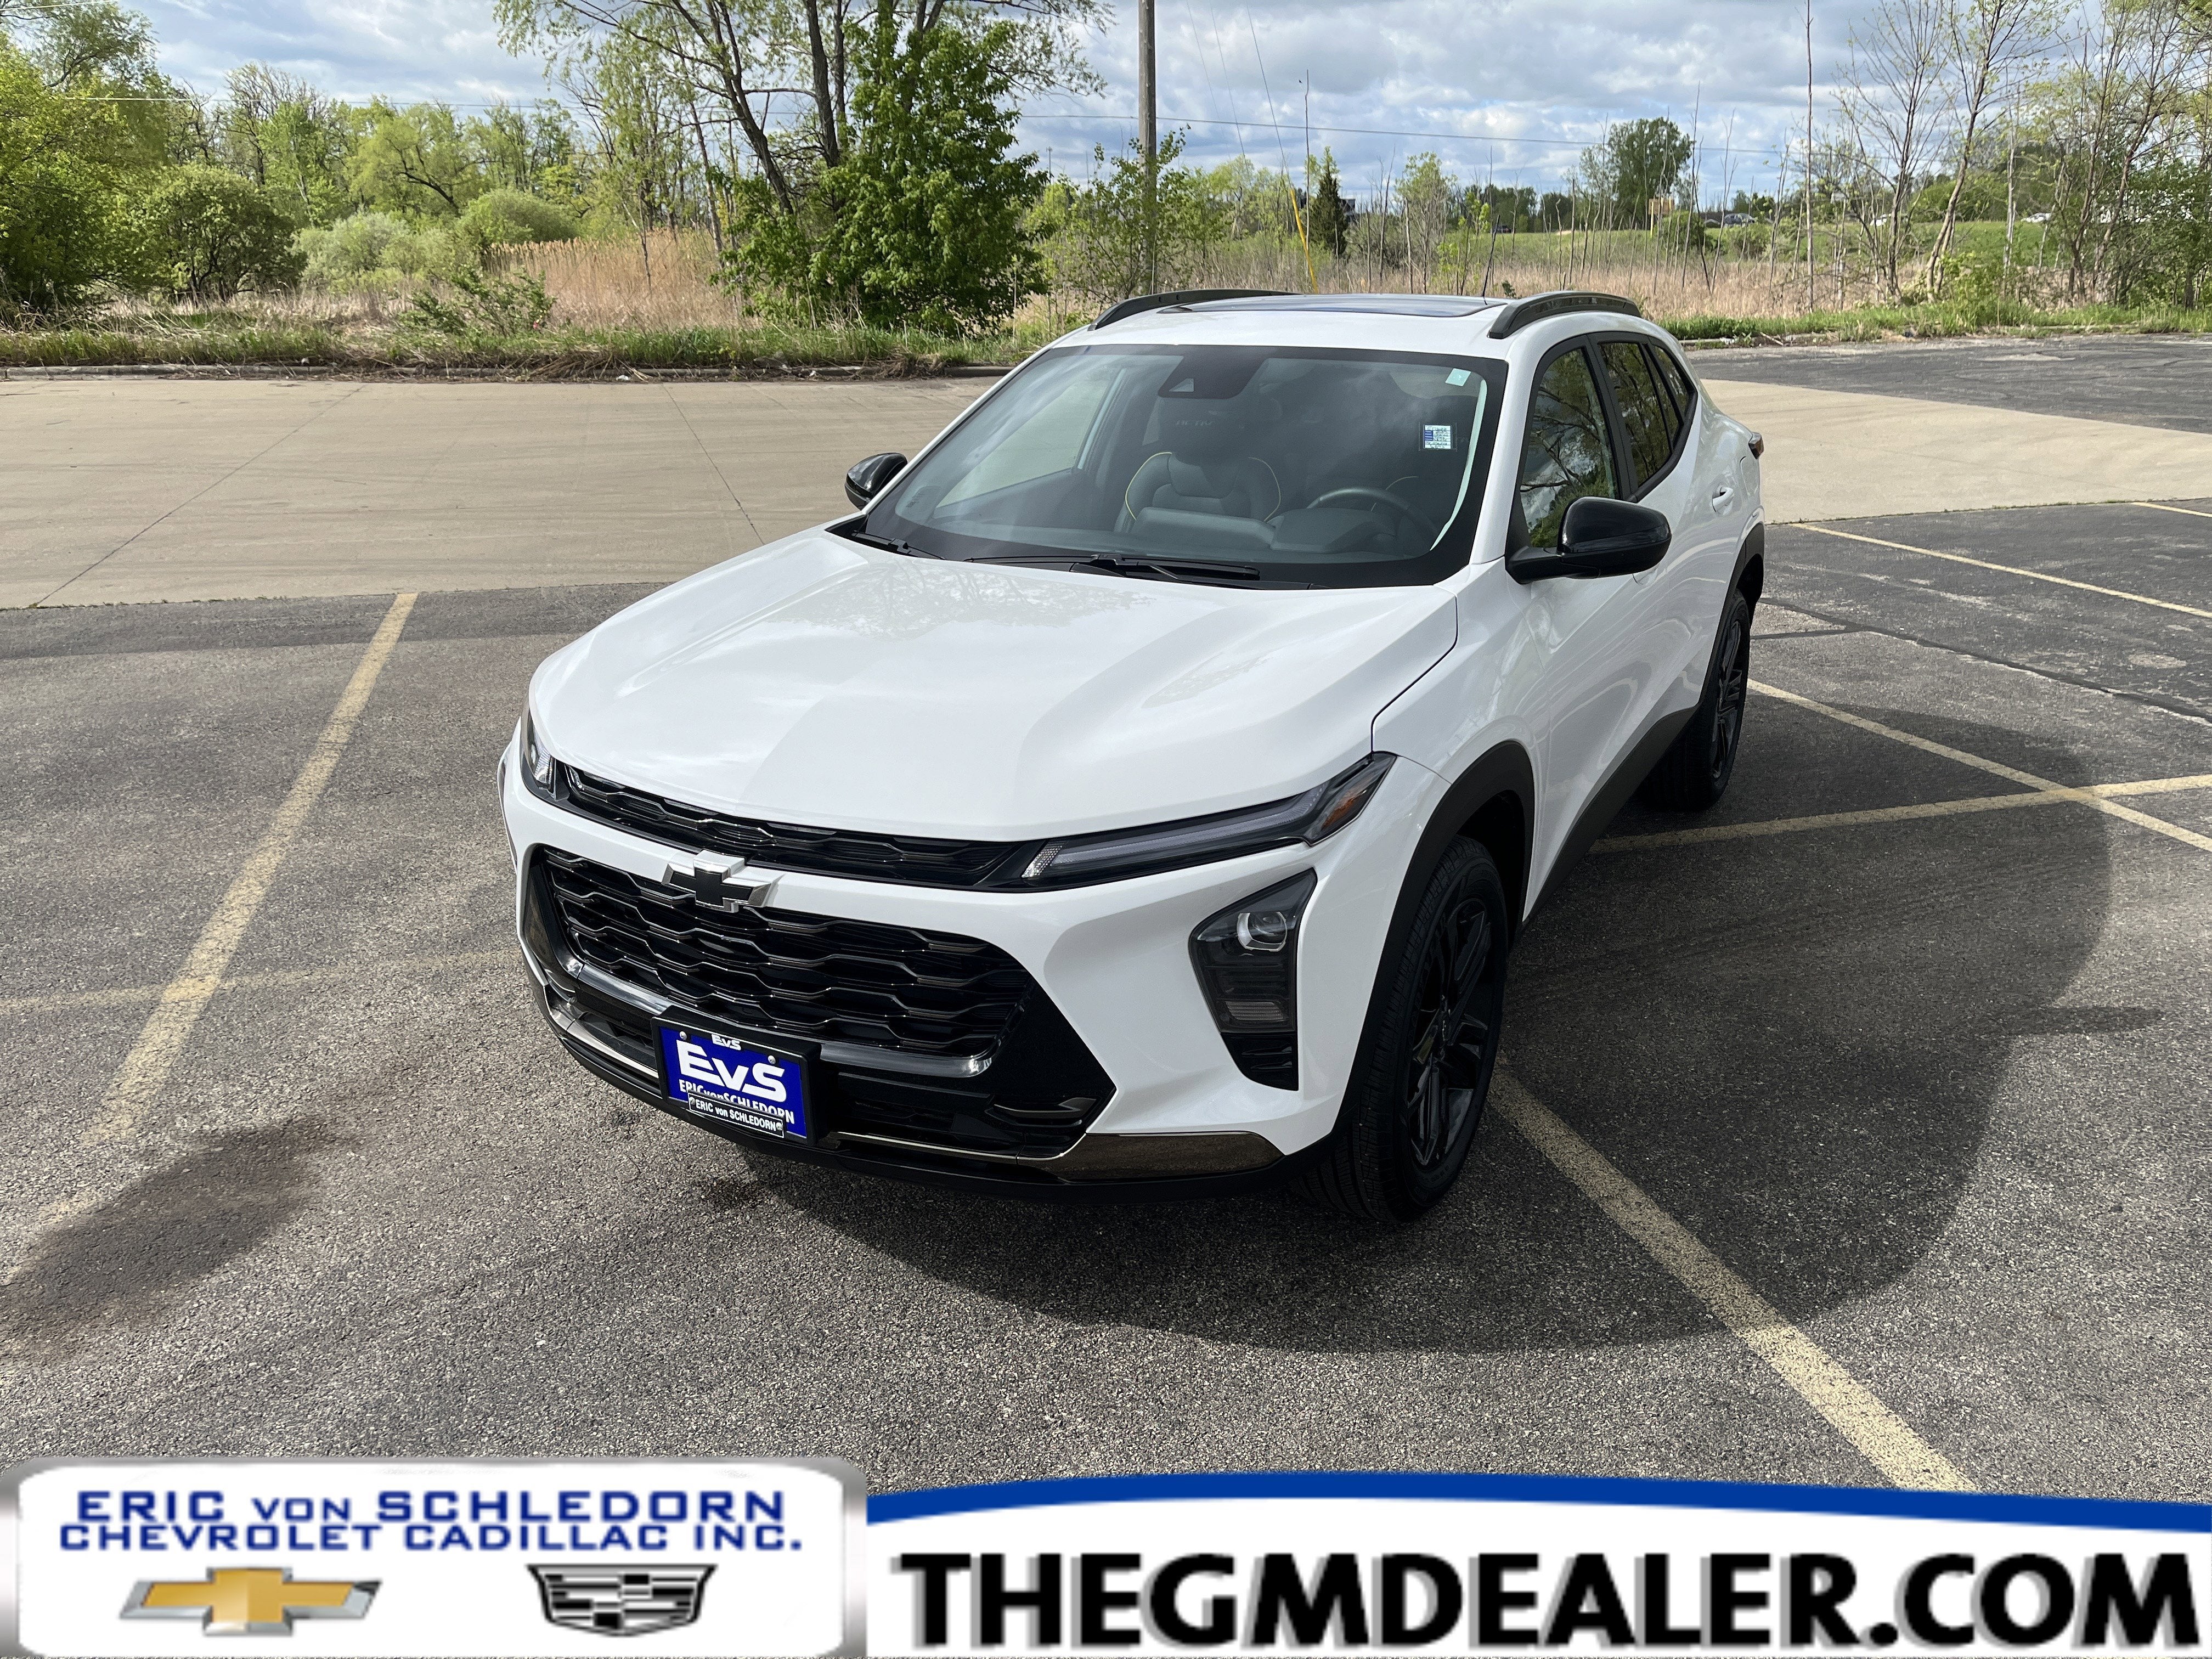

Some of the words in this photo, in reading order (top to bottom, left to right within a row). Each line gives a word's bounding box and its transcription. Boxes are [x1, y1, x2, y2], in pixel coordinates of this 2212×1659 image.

[696, 1099, 714, 1113] ERIC
[715, 1107, 729, 1117] von
[730, 1109, 777, 1131] SCHLEDORN
